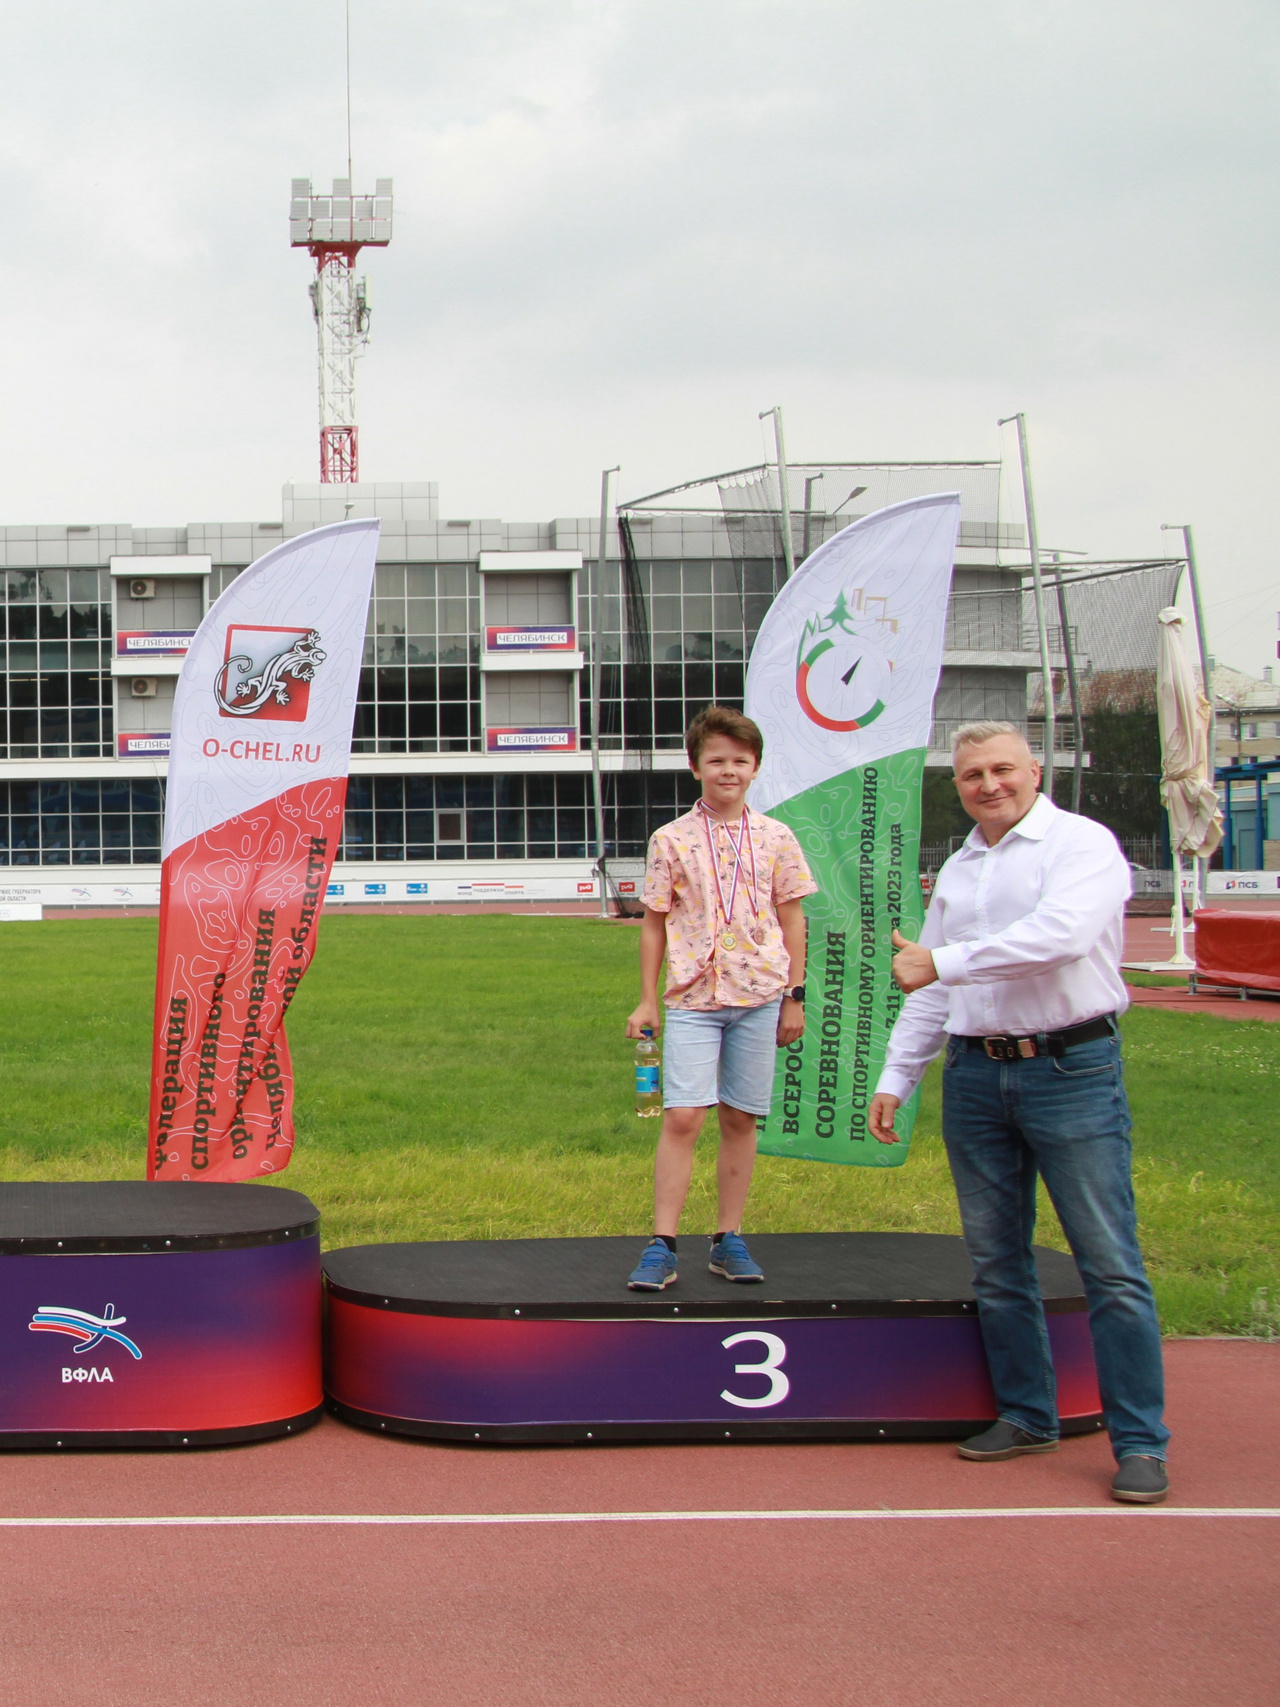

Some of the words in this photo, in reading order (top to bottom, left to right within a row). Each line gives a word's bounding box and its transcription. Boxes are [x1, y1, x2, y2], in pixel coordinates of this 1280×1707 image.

[498, 633, 566, 643] ЧЕЛЯБИНСК
[202, 738, 321, 764] O-CHEL.RU
[499, 734, 567, 744] ЧЕЛЯБИНСК
[859, 766, 878, 958] ОРИЕНТИРОВАНИЮ
[888, 823, 904, 867] года
[290, 836, 328, 964] области
[887, 870, 901, 913] 2023
[1238, 881, 1258, 889] ПСБ
[815, 931, 846, 1139] СОРЕВНОВАНИЯ
[851, 962, 875, 1110] СПОРТИВНОМУ
[191, 972, 226, 1170] спортивного
[850, 1113, 866, 1142] ПО
[61, 1366, 114, 1383] ВФЛА
[719, 1330, 790, 1409] 3
